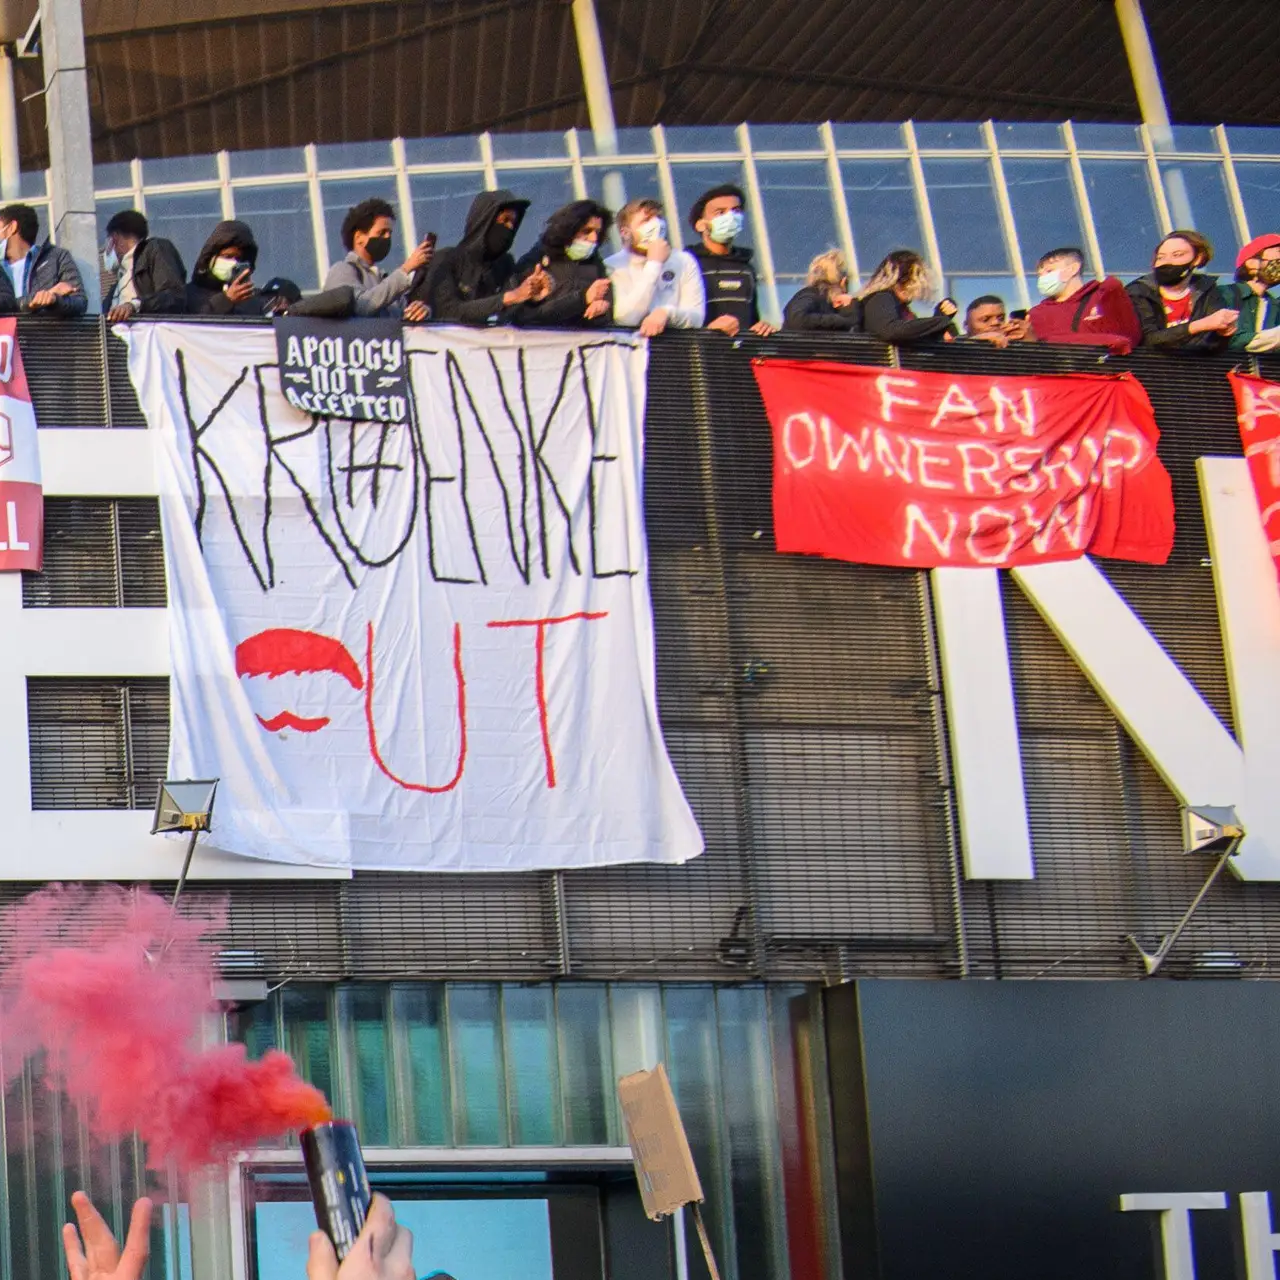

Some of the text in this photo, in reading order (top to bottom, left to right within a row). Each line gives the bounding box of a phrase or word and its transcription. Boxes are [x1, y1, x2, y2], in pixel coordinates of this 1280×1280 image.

[285, 335, 402, 373] APOLOGY
[285, 386, 407, 422] ACCEPTED
[311, 364, 370, 396] NOT
[876, 374, 1037, 437] FAN
[781, 410, 1142, 496] OWNERSHIP
[900, 494, 1088, 565] NOW
